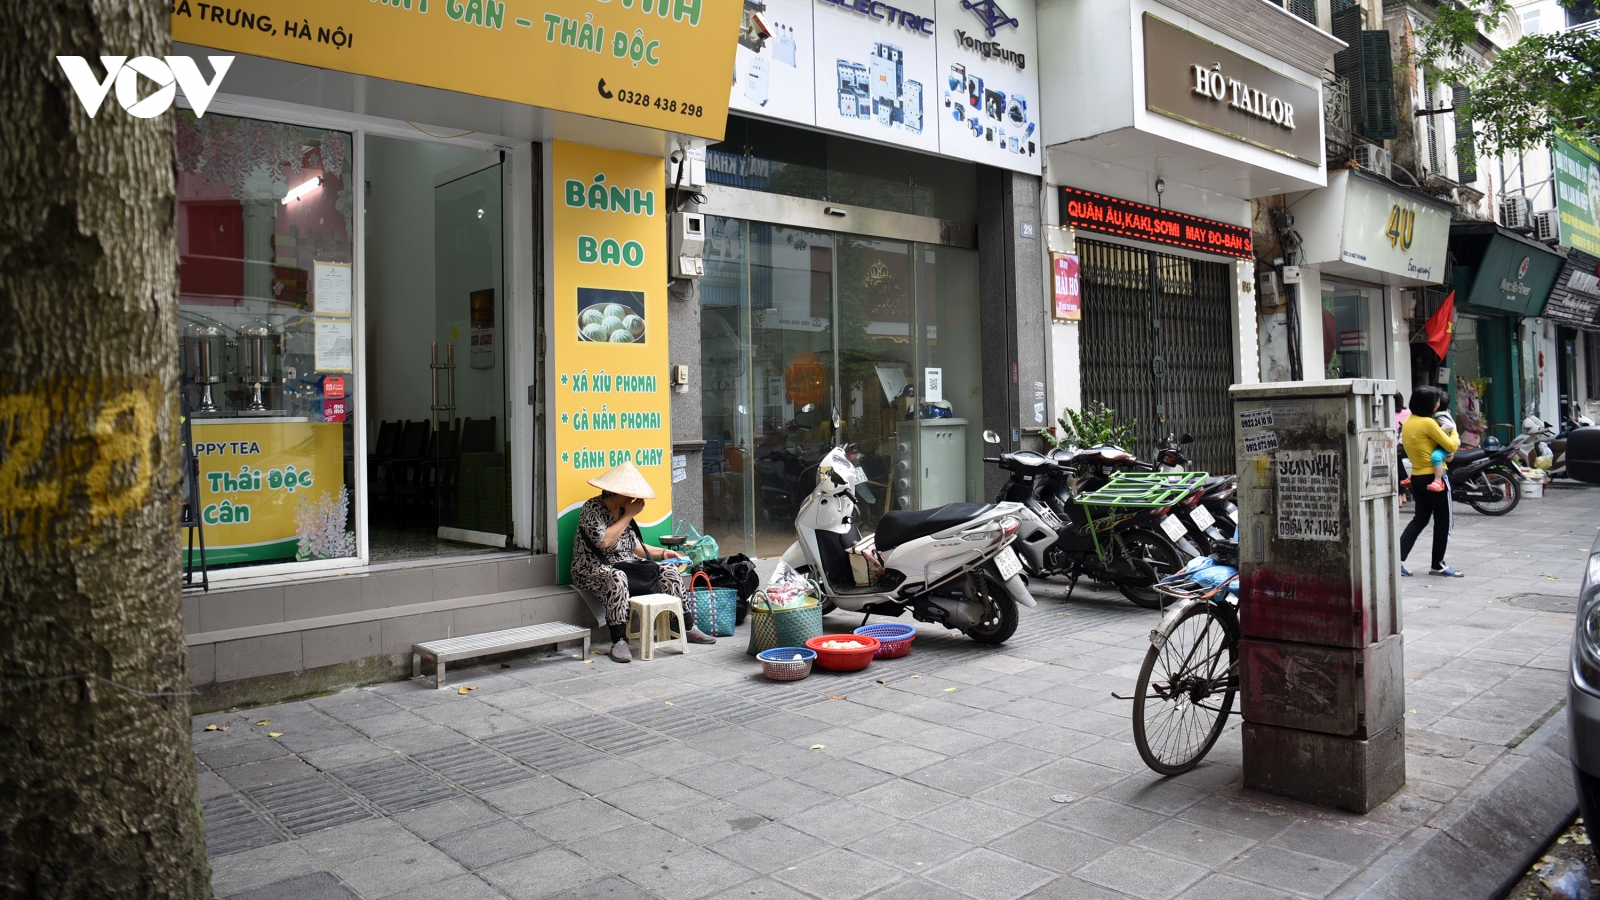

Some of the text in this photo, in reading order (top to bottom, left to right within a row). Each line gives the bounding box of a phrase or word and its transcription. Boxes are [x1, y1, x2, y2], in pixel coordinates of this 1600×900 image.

[197, 2, 277, 36] TRƯNG,
[283, 19, 313, 42] HÀ
[317, 26, 353, 50] NỘI
[823, 0, 935, 35] LECTRIC
[543, 12, 605, 53] THẢI
[611, 28, 660, 68] ĐỘC
[954, 29, 1026, 69] YongSung
[617, 89, 703, 118] 0328 438 298
[1229, 75, 1296, 129] TAILOR
[565, 172, 655, 217] BÁNH
[1023, 225, 1033, 236] 28
[1185, 225, 1207, 243] MAY
[1386, 204, 1415, 251] 4U
[577, 234, 645, 268] BAO
[572, 369, 657, 393] XÁ XÍU PHOMAI
[572, 404, 661, 431] GÀ NẤM PHOMAI
[195, 441, 260, 456] PPY TEA
[573, 446, 605, 469] BÁNH
[635, 448, 663, 466] CHAY
[207, 464, 313, 493] Thải Độc
